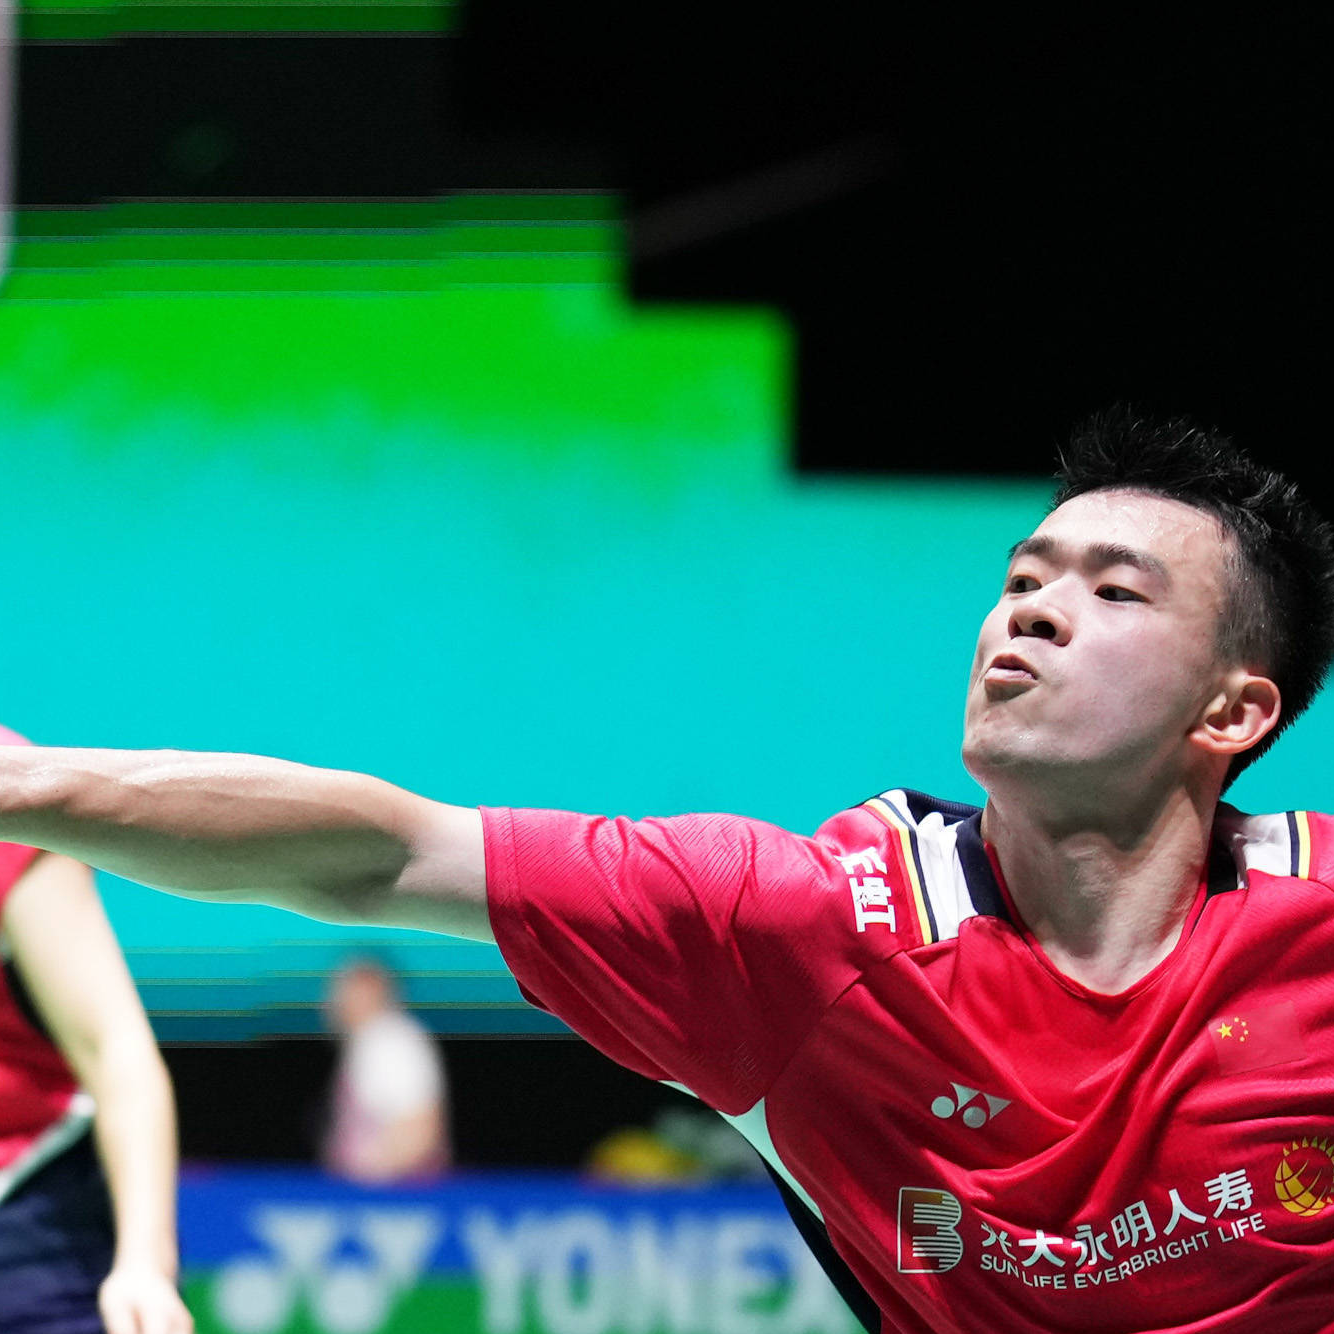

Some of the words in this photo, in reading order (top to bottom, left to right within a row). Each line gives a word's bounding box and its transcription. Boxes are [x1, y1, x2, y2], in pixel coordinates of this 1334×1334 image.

[980, 1253, 1020, 1279] SUN
[1021, 1270, 1068, 1290] LIFE
[1073, 1230, 1210, 1290] EVERBRIGHT
[1219, 1212, 1266, 1242] LIFE
